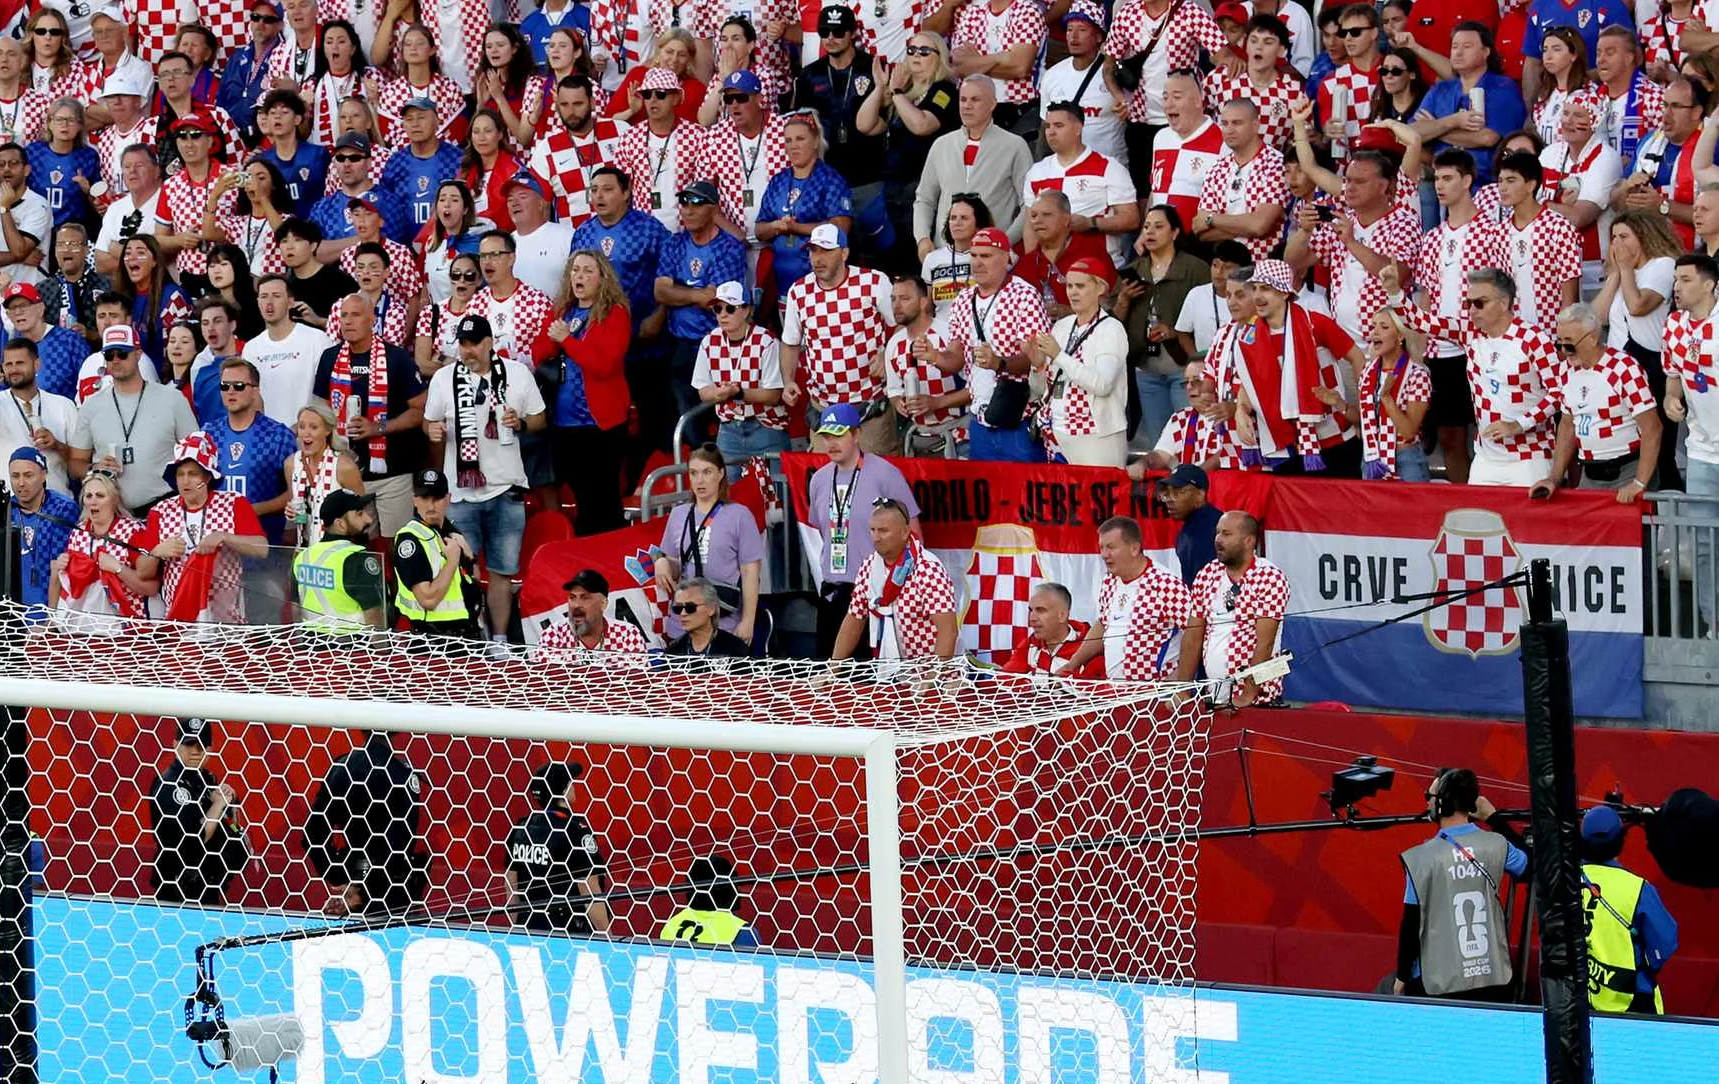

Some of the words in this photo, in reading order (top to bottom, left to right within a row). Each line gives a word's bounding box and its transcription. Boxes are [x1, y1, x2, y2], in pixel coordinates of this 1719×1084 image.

[46, 187, 64, 209] 10
[414, 202, 430, 224] 10
[914, 478, 991, 523] ORILO
[1019, 480, 1081, 526] JEBE
[1090, 481, 1120, 525] SE
[298, 567, 334, 588] OLICE
[1318, 553, 1408, 605] CRVE
[513, 843, 550, 866] POLICE
